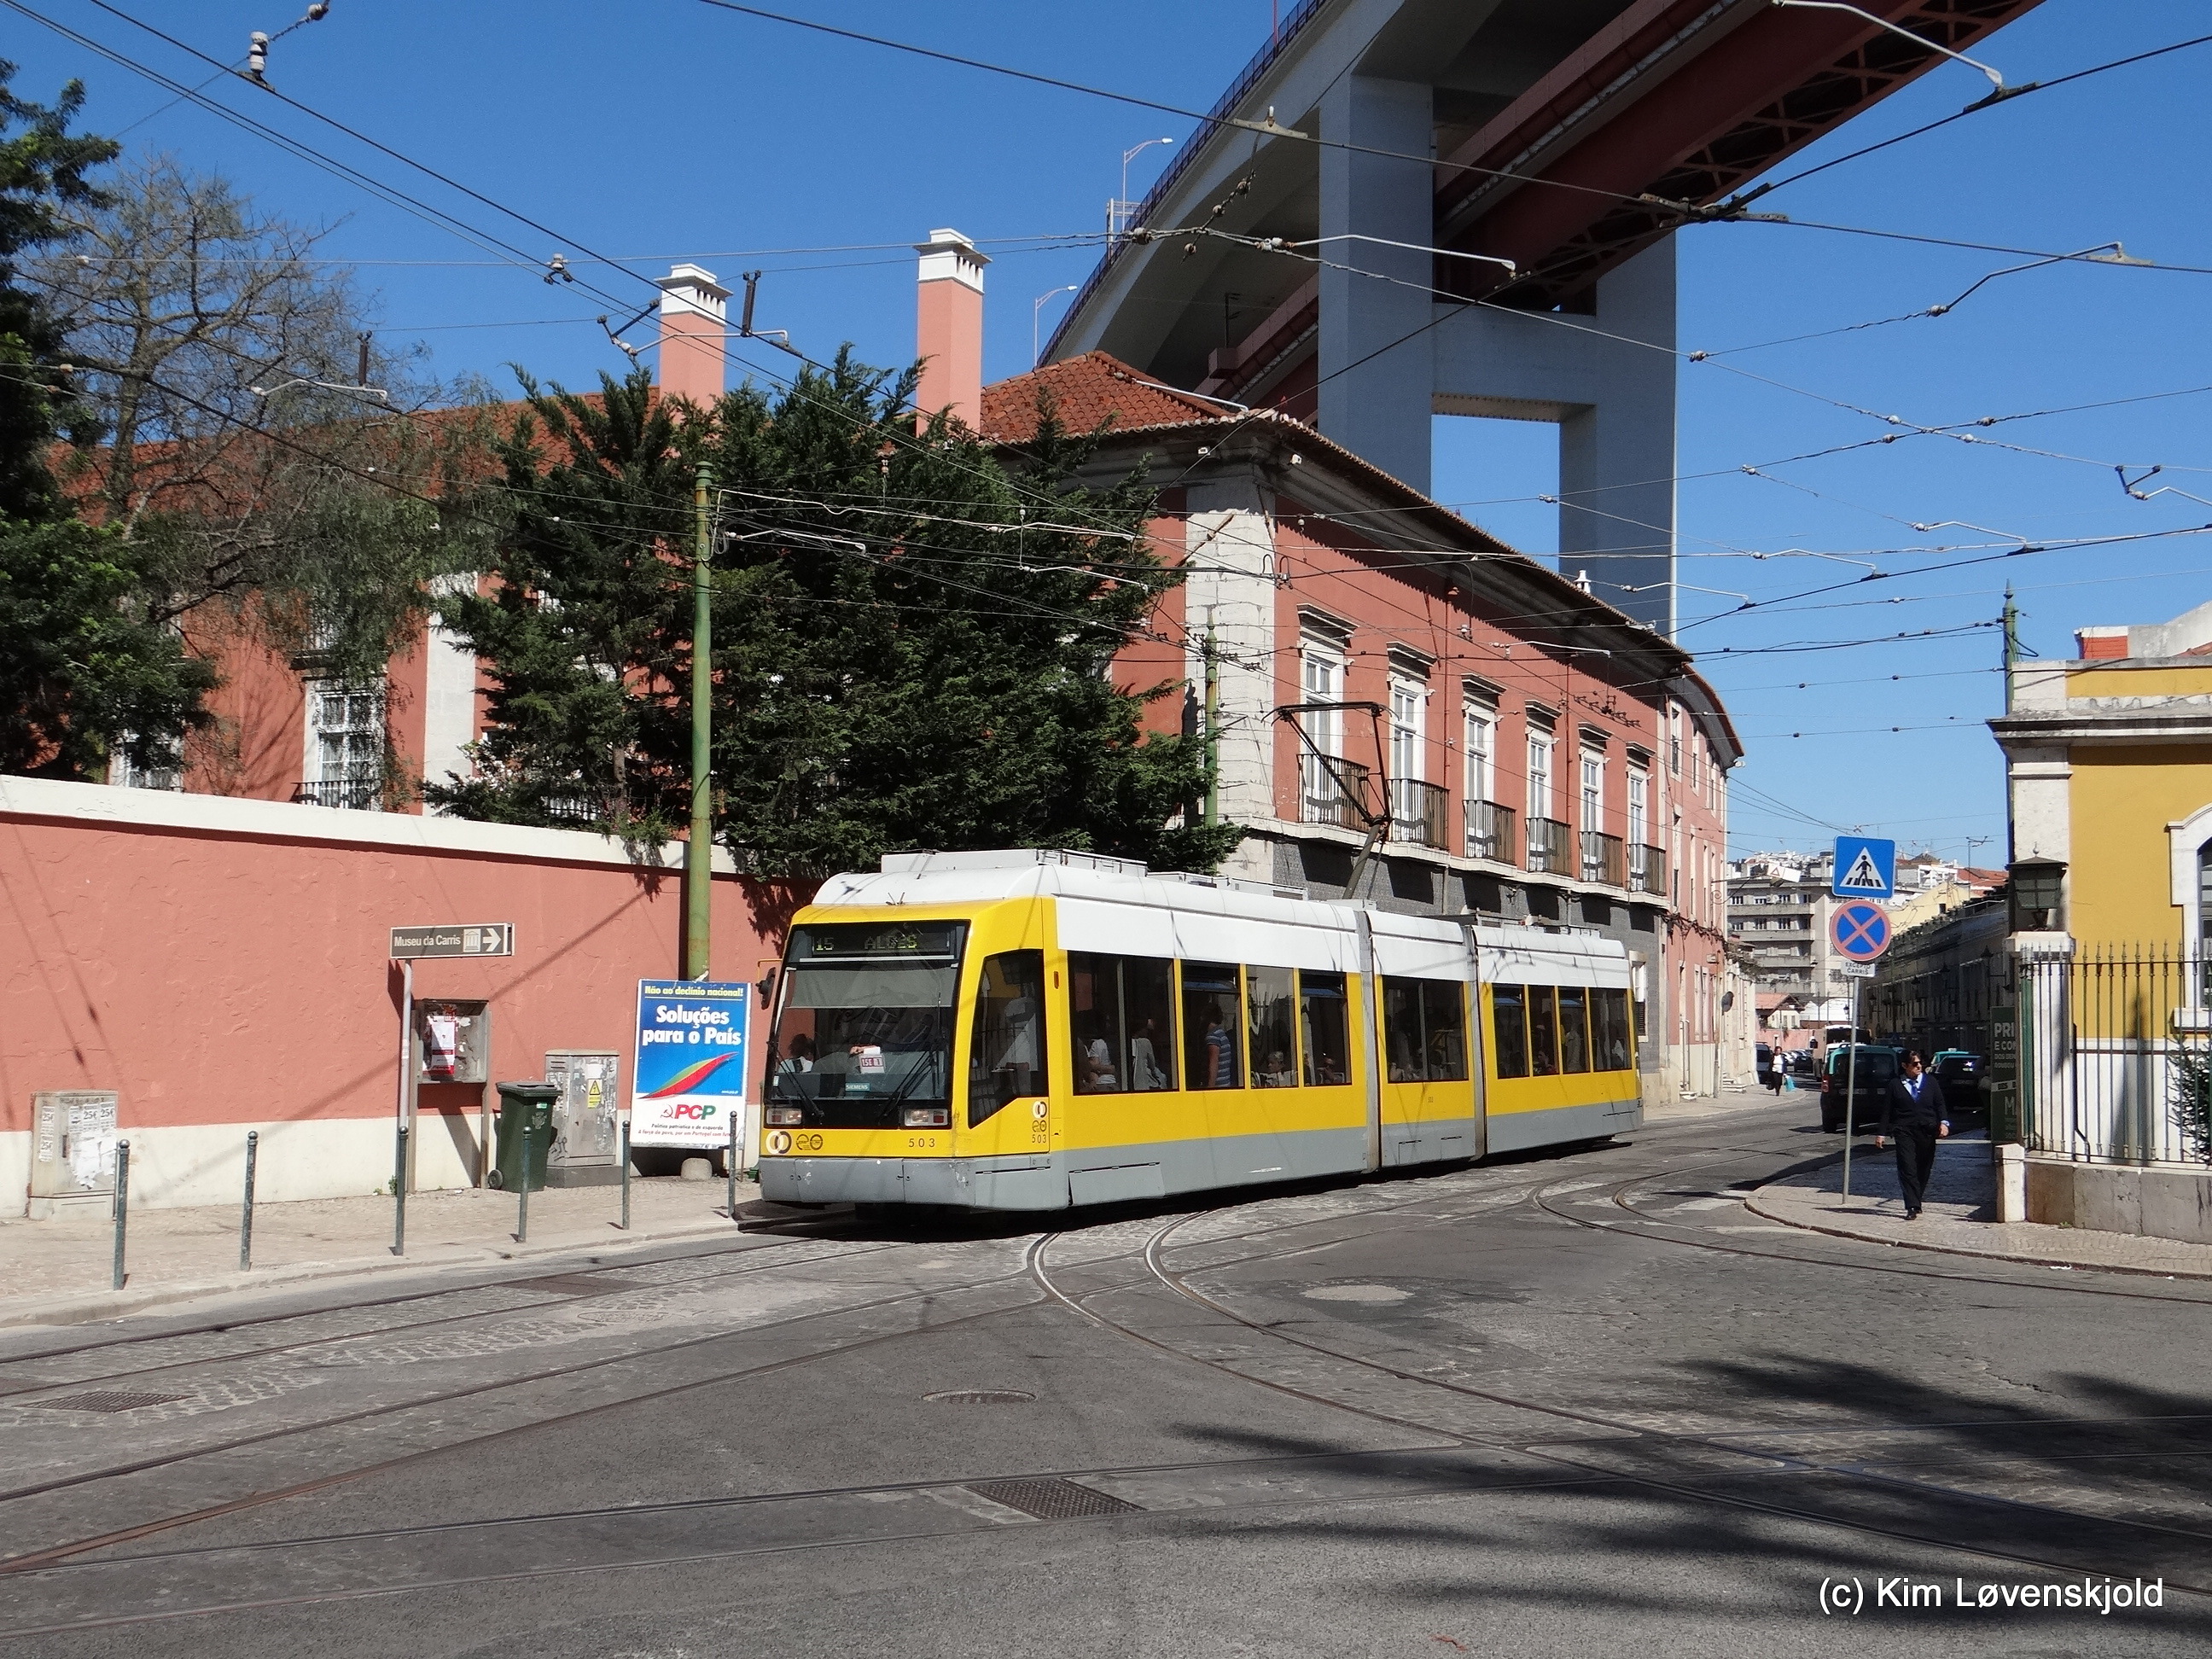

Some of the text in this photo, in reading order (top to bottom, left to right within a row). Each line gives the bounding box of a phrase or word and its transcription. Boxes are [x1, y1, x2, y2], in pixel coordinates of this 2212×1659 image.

[393, 934, 461, 947] Museu da Carris
[644, 986, 661, 995] Não
[675, 986, 706, 996] declínio
[707, 987, 744, 997] nacional!
[655, 1004, 730, 1029] Soluções
[642, 1027, 742, 1046] para o País
[674, 1103, 717, 1120] PCP
[908, 1138, 935, 1148] 503
[1032, 1134, 1047, 1144] 503
